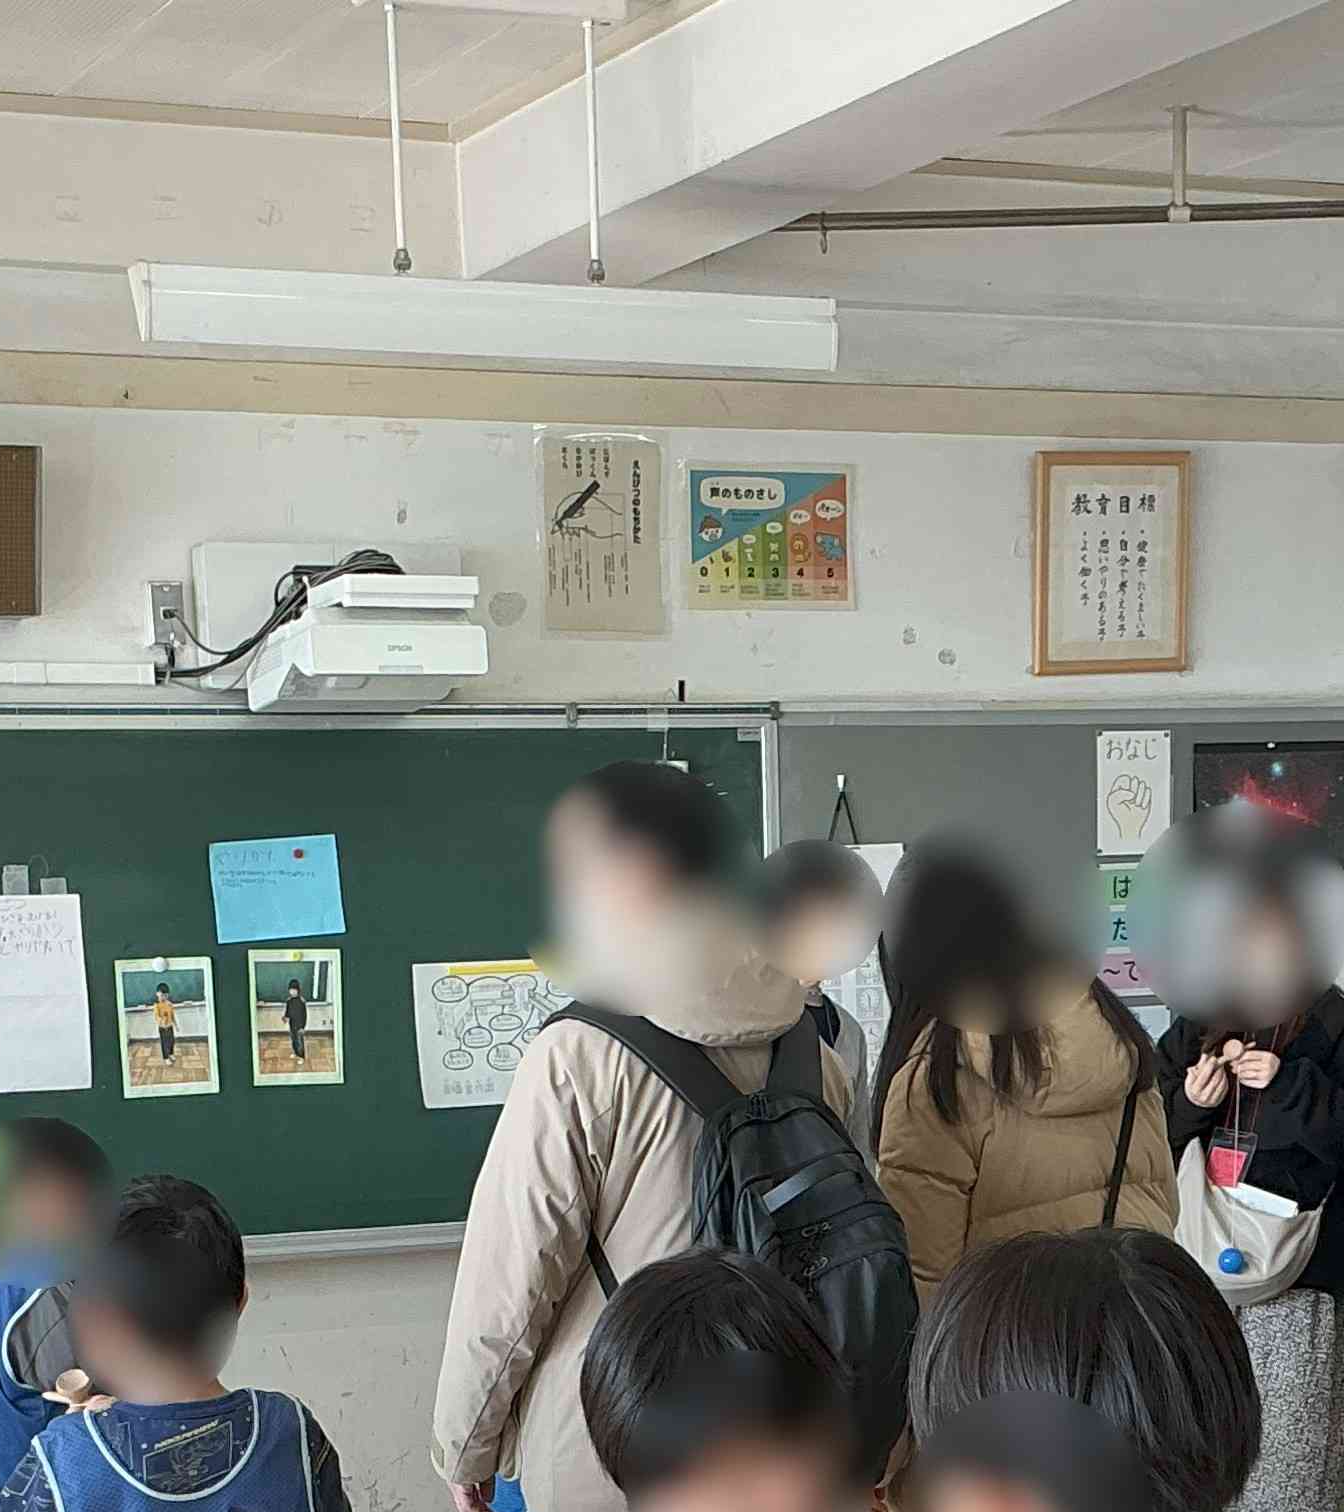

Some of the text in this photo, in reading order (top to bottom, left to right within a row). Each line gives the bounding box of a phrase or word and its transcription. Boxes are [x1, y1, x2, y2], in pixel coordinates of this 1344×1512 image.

[709, 485, 778, 500] 声のものさし
[1071, 492, 1157, 516] 教育目標
[1105, 737, 1159, 762] おなじ
